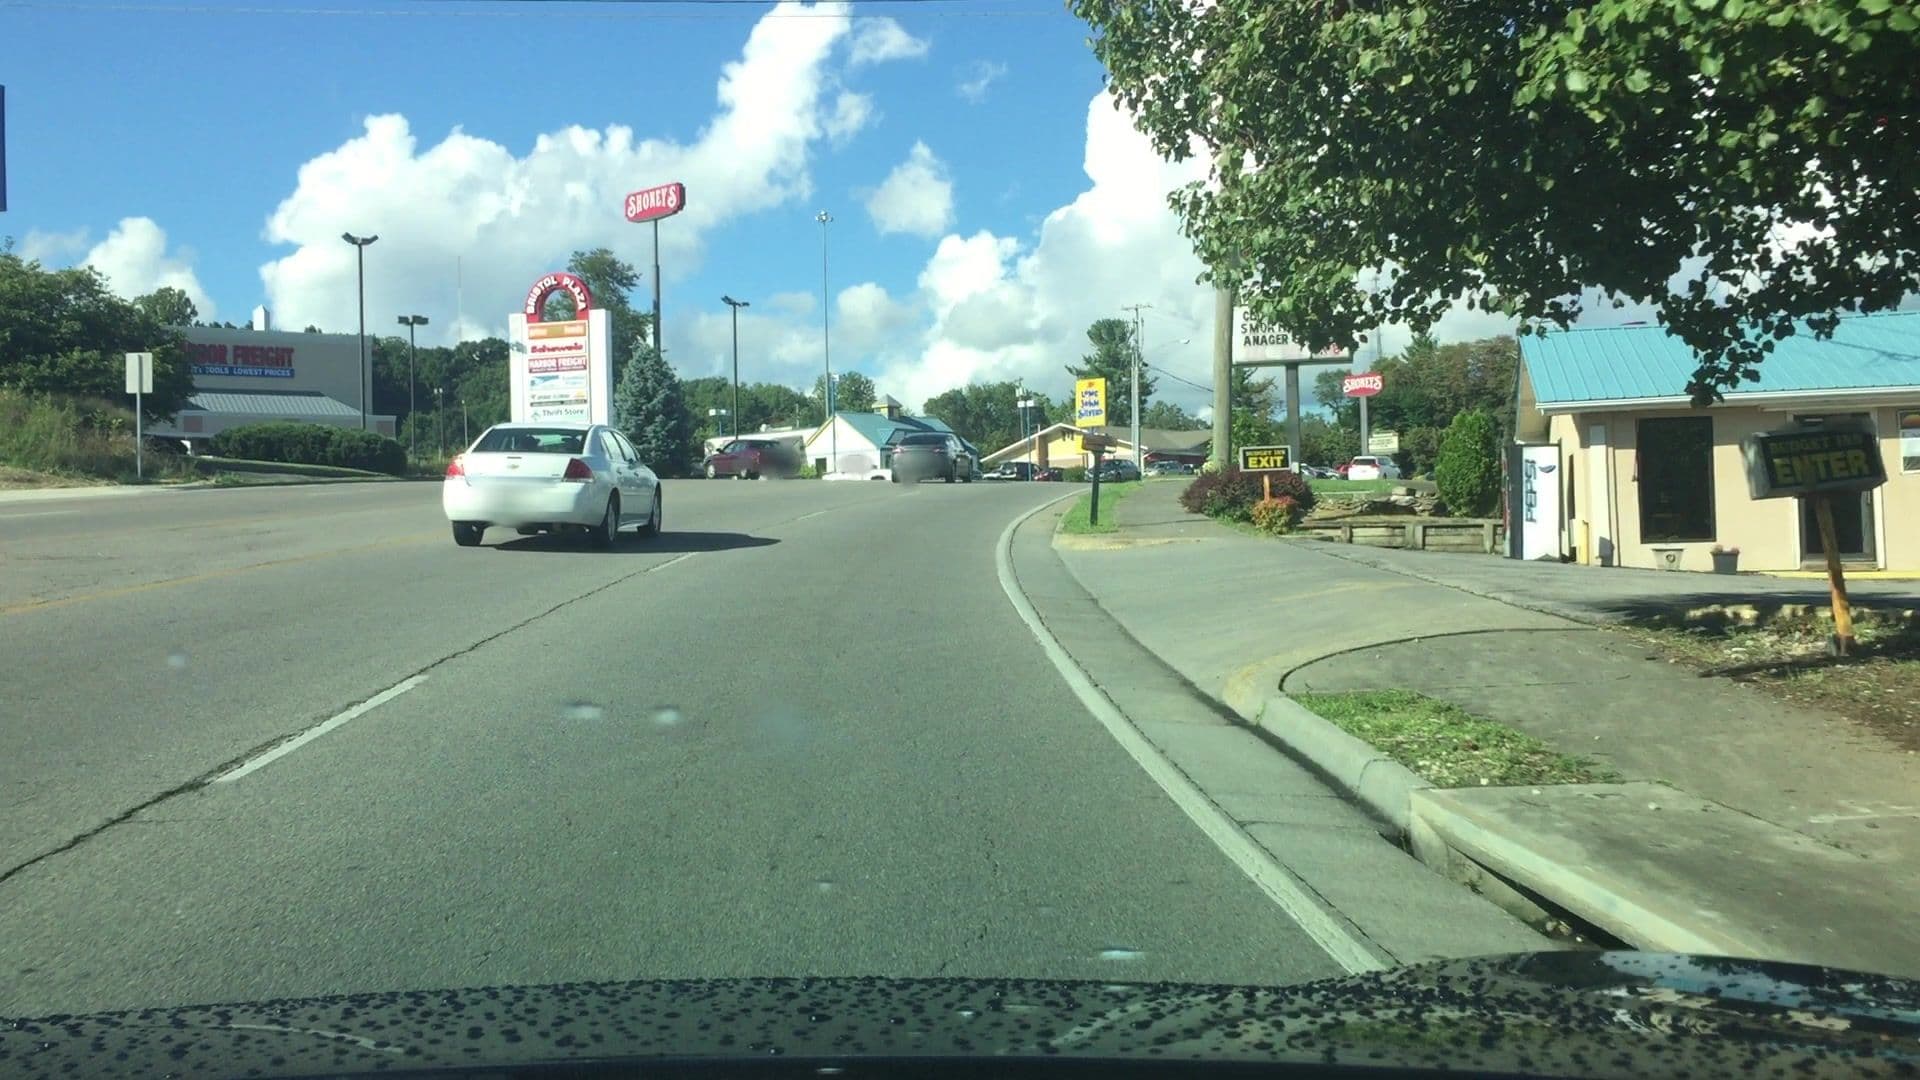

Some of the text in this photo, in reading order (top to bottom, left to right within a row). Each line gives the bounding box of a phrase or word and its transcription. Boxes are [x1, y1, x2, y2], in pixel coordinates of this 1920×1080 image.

[526, 275, 587, 314] BRISTOL PLAZA
[1247, 455, 1284, 468] EXIT
[1772, 449, 1871, 485] ENTER
